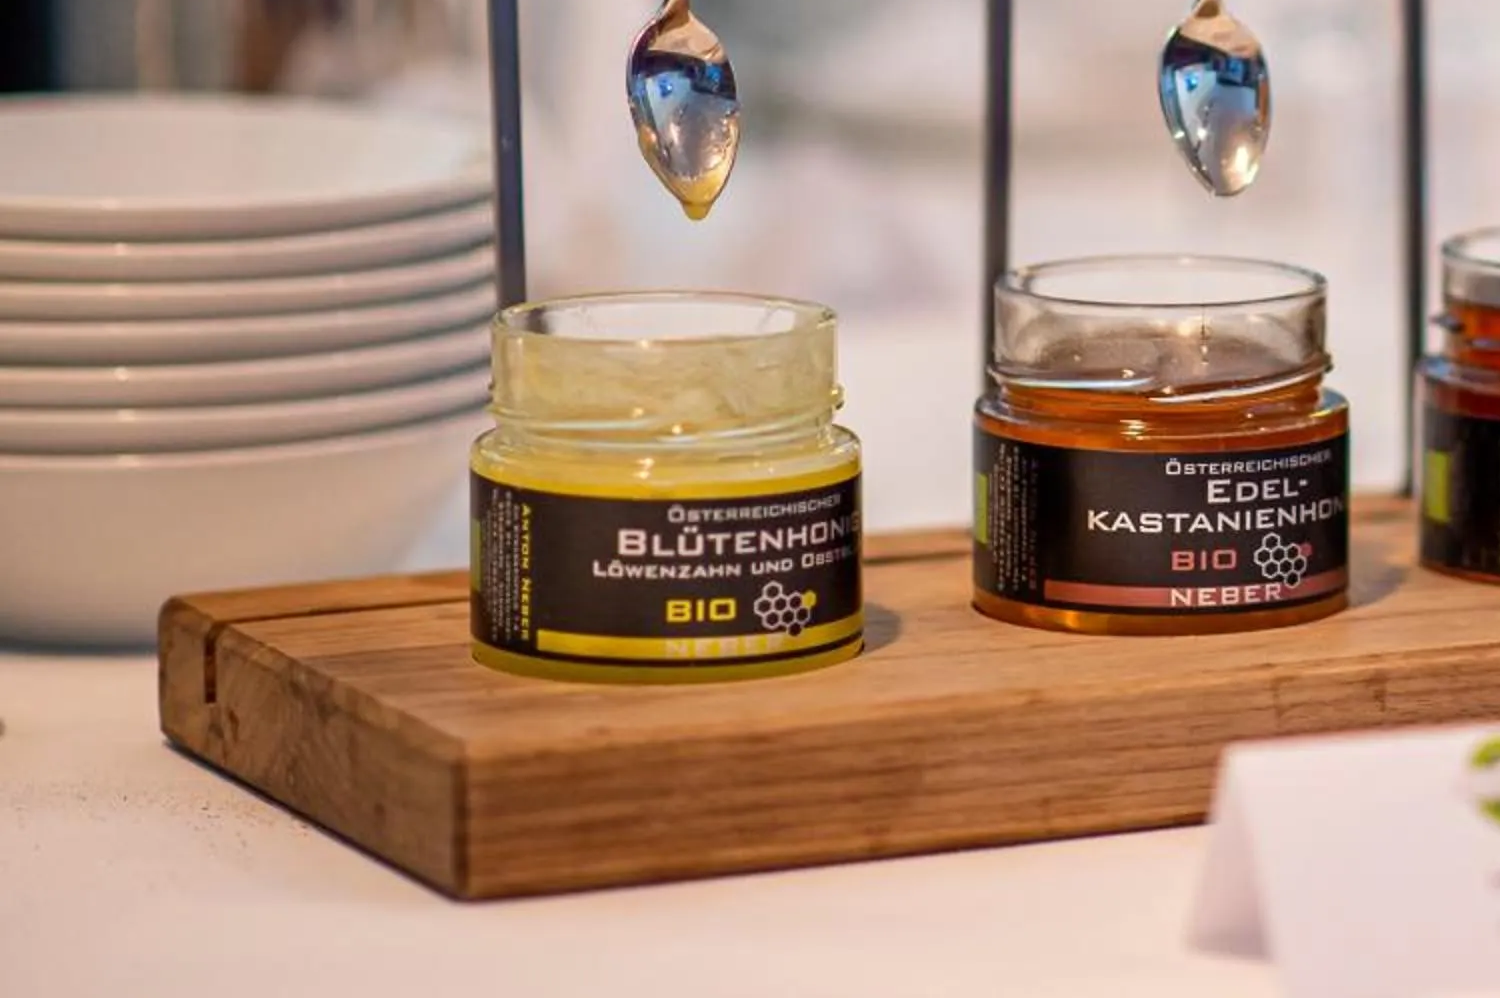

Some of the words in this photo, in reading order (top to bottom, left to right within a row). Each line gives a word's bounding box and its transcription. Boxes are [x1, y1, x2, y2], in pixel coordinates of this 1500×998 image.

[1206, 477, 1308, 504] EDEL-
[592, 559, 742, 579] LÖWENZAHN
[751, 558, 794, 576] UND
[1171, 548, 1238, 572] BIO
[1170, 583, 1283, 607] NEBER
[666, 598, 737, 623] BIO
